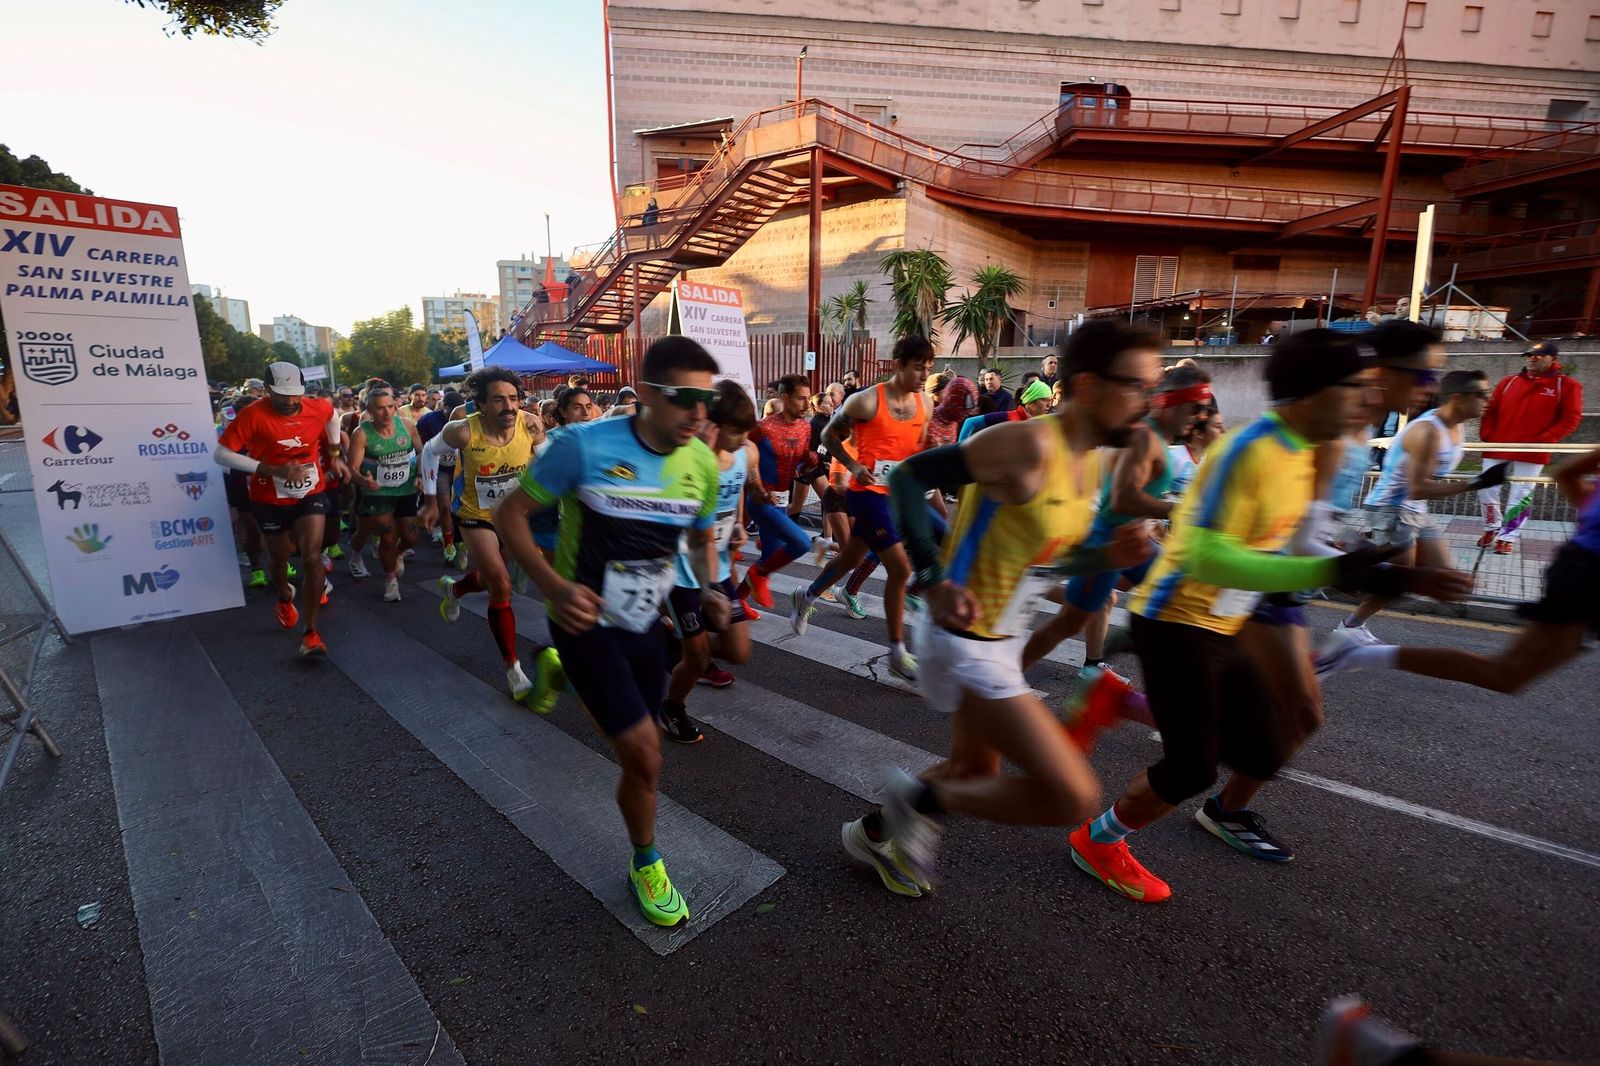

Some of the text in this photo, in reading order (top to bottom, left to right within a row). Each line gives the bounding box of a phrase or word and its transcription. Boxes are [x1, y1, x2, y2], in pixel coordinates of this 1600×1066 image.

[0, 191, 173, 233] SALIDA
[1, 229, 179, 267] XIV CARRERA
[18, 265, 173, 288] SAN SILVESTRE
[6, 283, 189, 307] PALMA PALMILLA
[681, 284, 739, 304] SALIDA
[684, 305, 742, 324] XIV CARRERA
[690, 325, 741, 337] SAN SILVESTRE
[692, 337, 746, 348] ALMA PALMILLA
[89, 344, 164, 359] Ciudad
[93, 363, 197, 380] de Málaga
[138, 442, 208, 456] ROSALEDA
[43, 455, 114, 467] Carrefour
[284, 476, 312, 489] 405
[384, 471, 405, 480] 689
[160, 518, 196, 537] BCM
